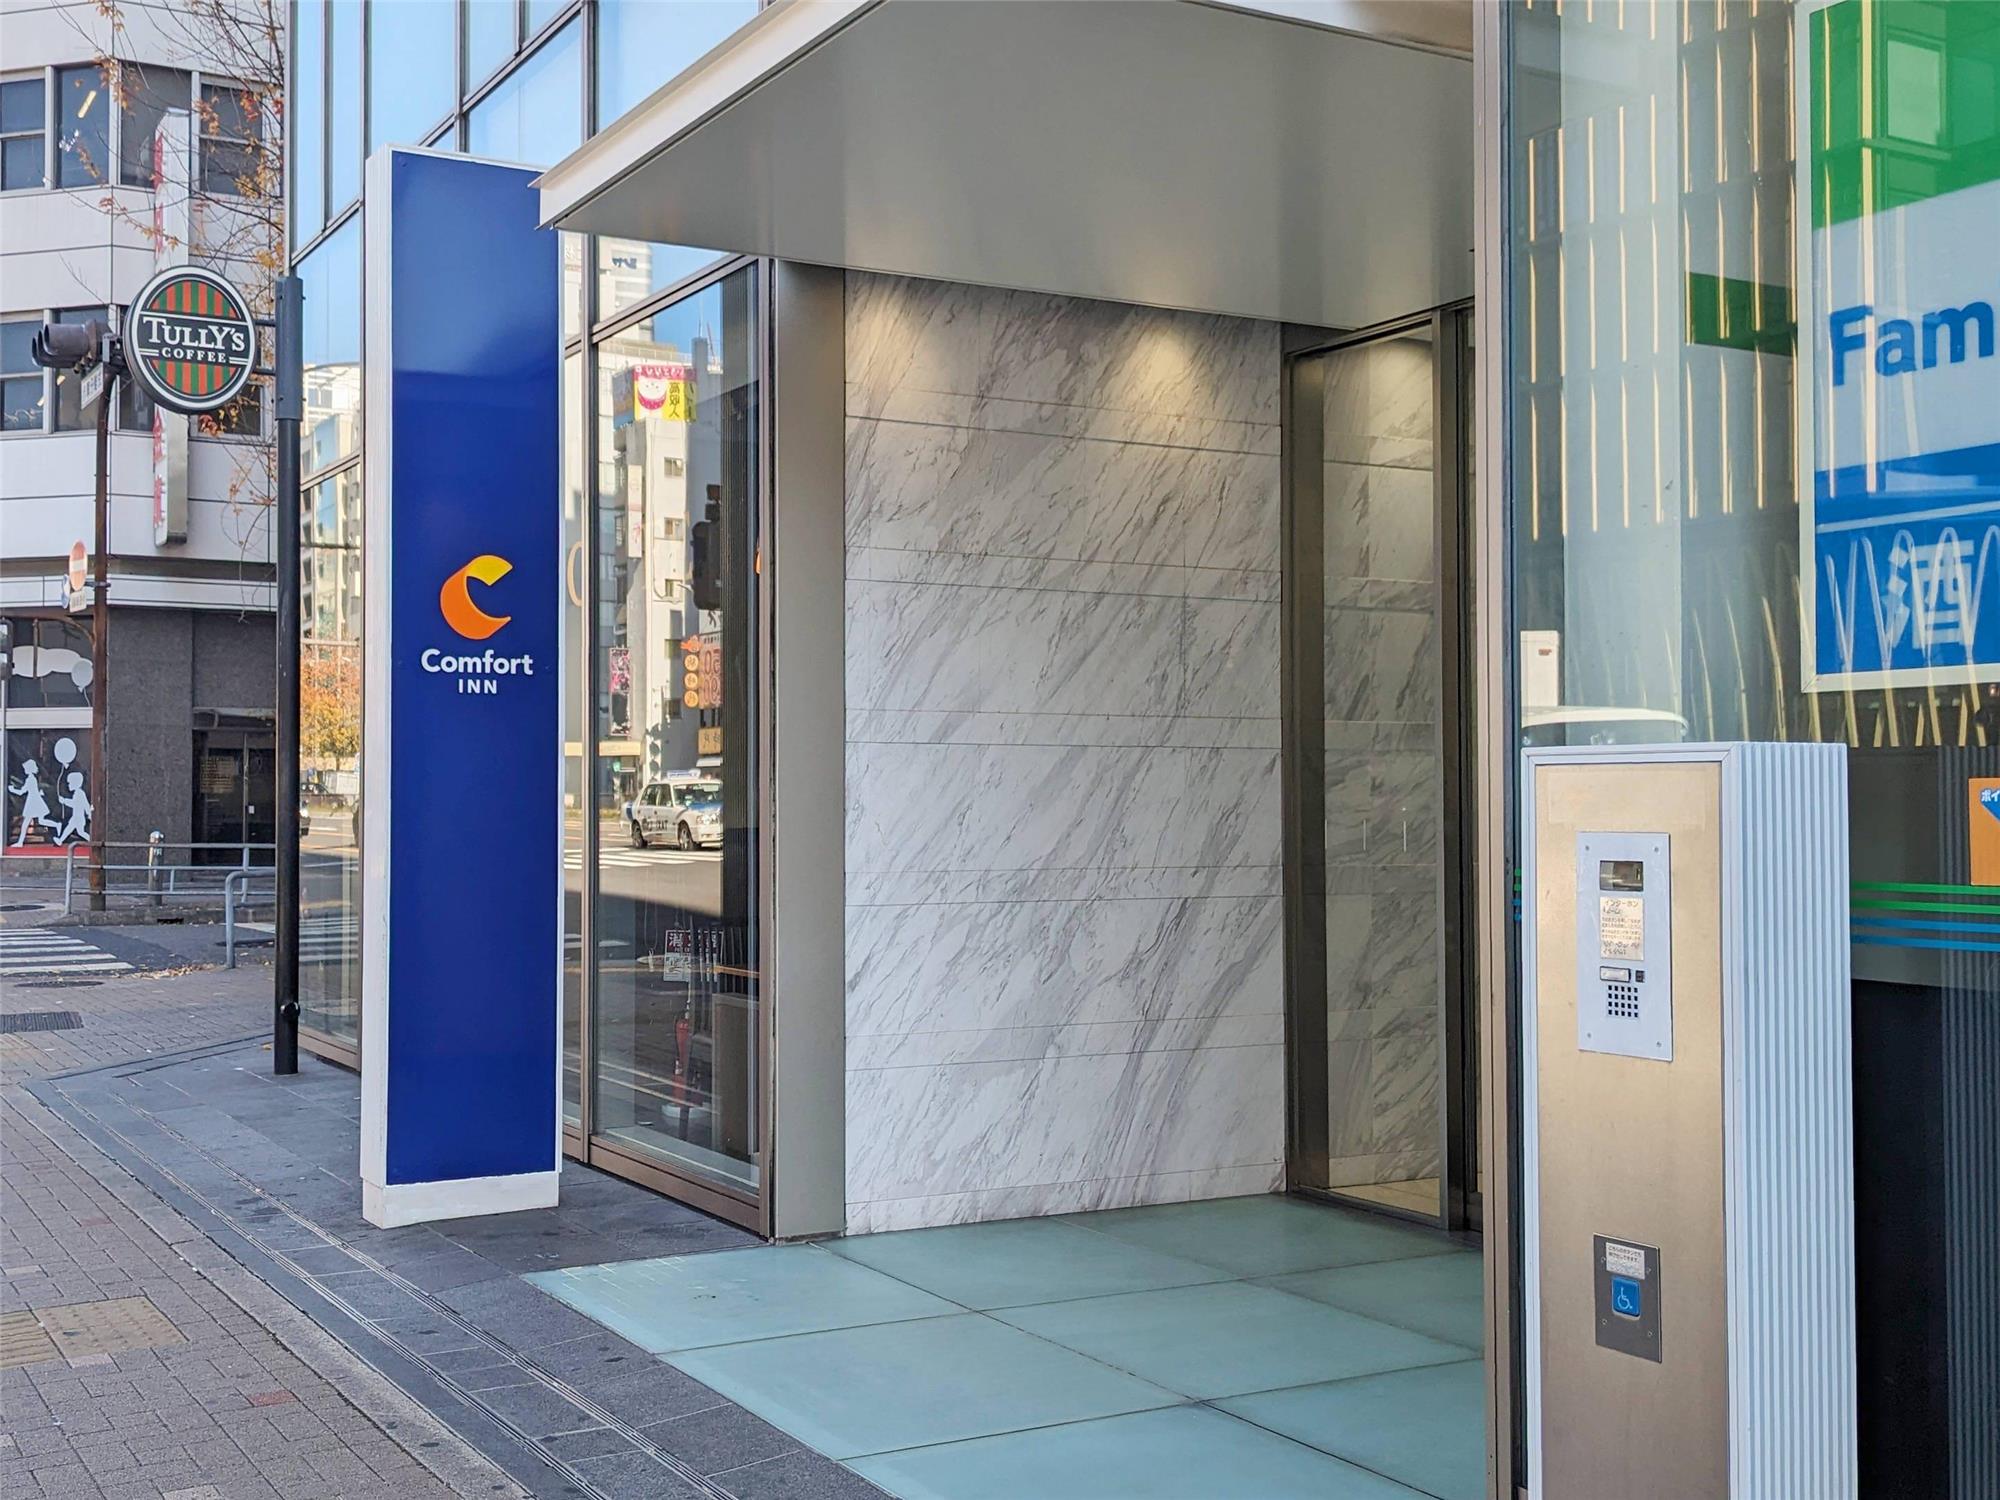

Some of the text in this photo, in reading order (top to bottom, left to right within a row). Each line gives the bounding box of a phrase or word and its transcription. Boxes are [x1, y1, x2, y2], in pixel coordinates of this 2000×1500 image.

[143, 317, 246, 352] TULLY'S
[1829, 301, 1994, 387] Fam
[162, 347, 226, 363] COFFEE
[1885, 538, 1976, 650] 酒
[421, 648, 534, 675] Comfort
[458, 679, 497, 694] INN
